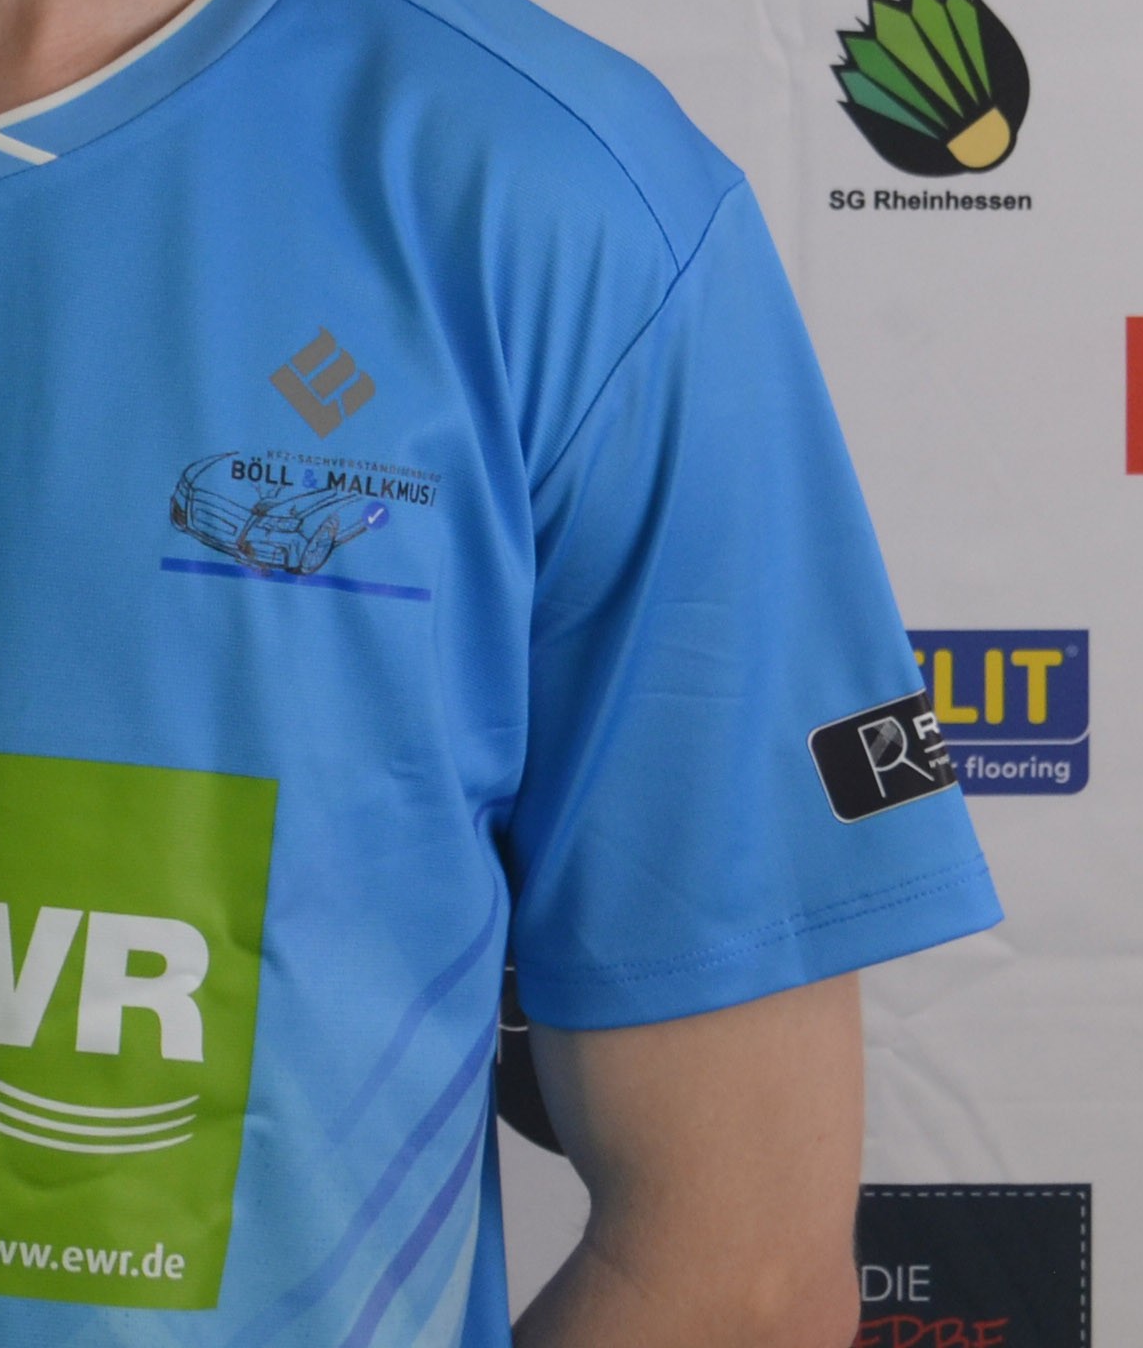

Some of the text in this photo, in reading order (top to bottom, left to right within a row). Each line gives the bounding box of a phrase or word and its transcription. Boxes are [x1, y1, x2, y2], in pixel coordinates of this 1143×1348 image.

[829, 190, 1033, 211] SG Rheinhessen
[230, 457, 294, 486] BÖLL
[302, 468, 318, 489] &
[914, 648, 1063, 725] LIT
[965, 755, 1071, 783] flooring
[861, 1265, 931, 1302] DIE
